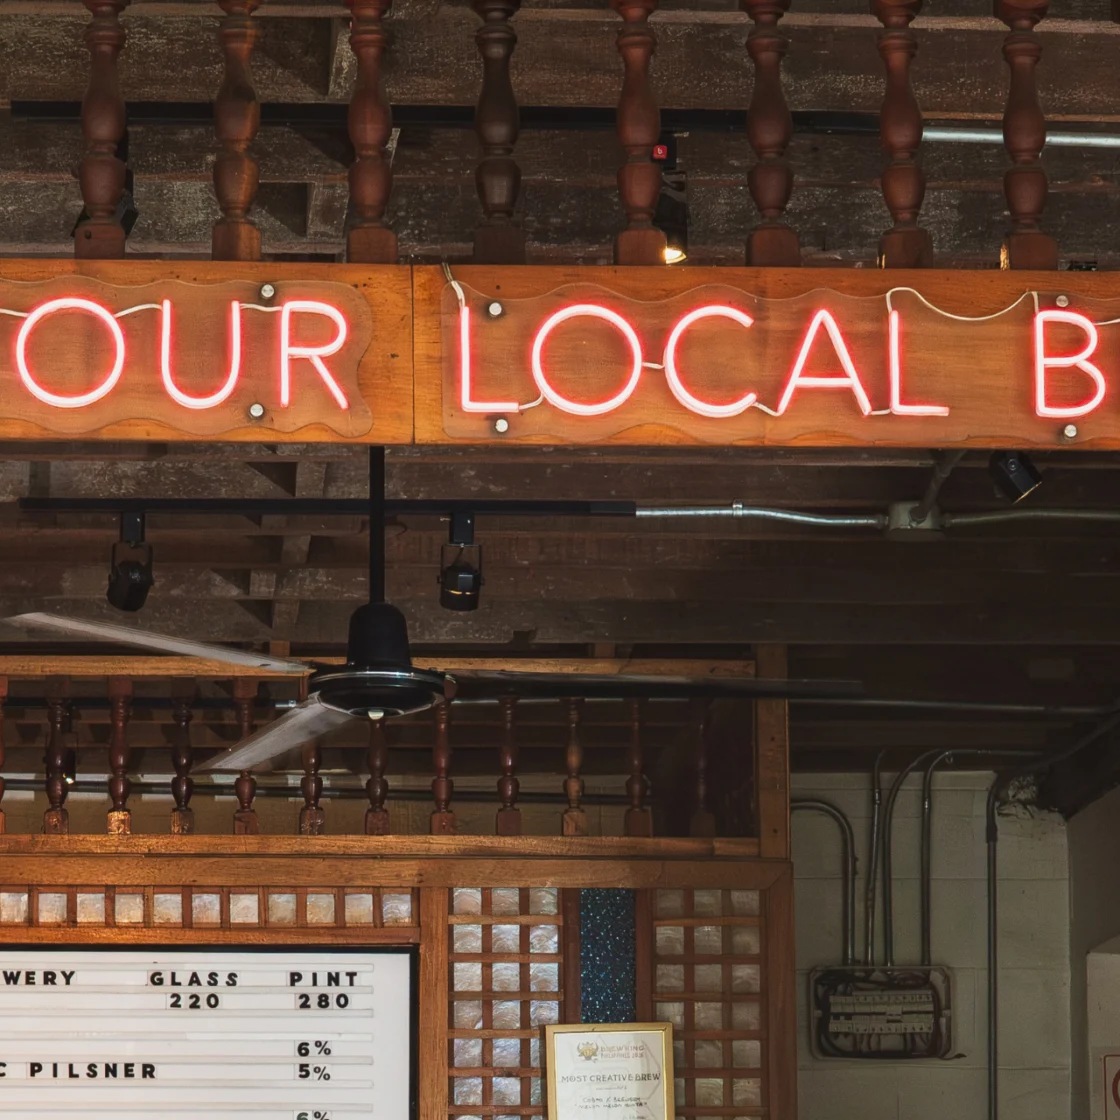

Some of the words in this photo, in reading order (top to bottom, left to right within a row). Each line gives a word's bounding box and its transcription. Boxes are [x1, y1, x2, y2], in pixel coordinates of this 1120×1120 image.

[459, 303, 950, 417] LOCAL
[1034, 309, 1107, 418] B
[149, 972, 238, 987] GLASS
[290, 972, 358, 987] PINT
[169, 993, 220, 1009] 220
[298, 993, 349, 1009] 280
[297, 1041, 332, 1057] 6%
[30, 1062, 156, 1079] PILSNER
[298, 1064, 331, 1081] 5%
[561, 1075, 587, 1083] MOST
[589, 1073, 634, 1082] CREATIVE
[635, 1072, 661, 1082] BREW
